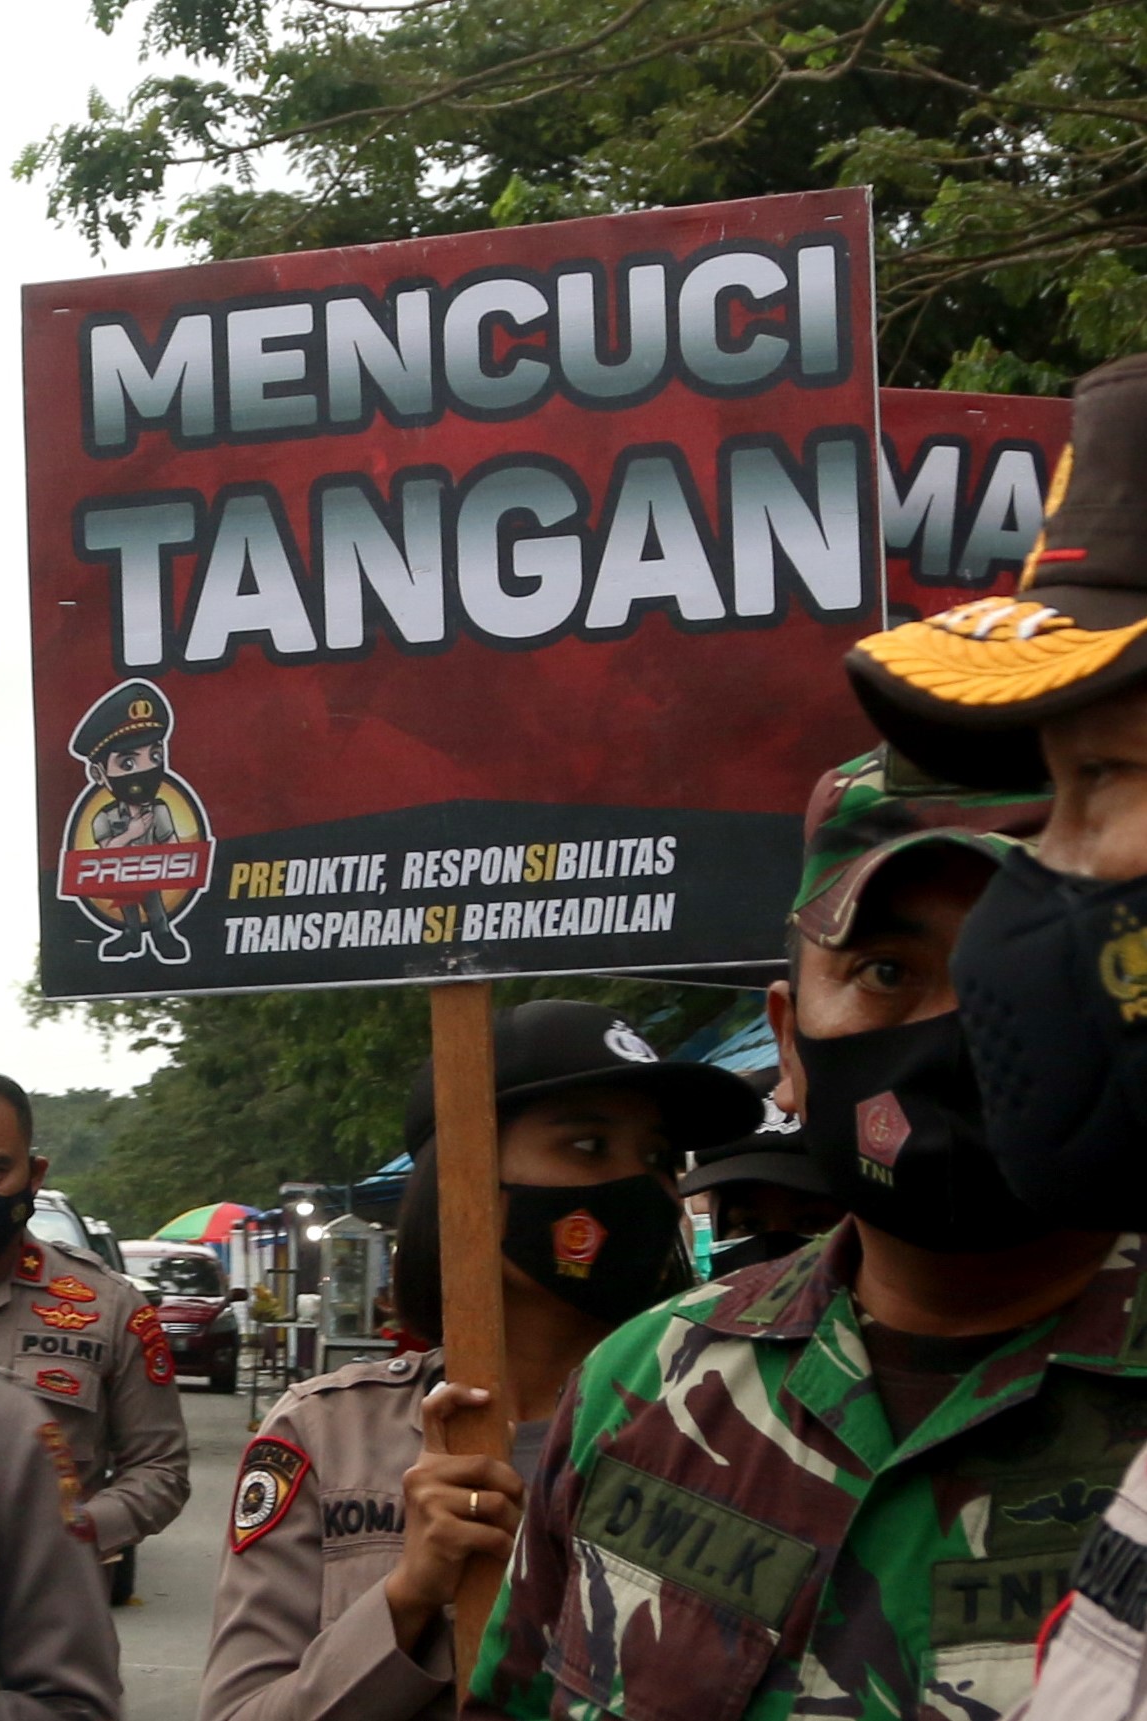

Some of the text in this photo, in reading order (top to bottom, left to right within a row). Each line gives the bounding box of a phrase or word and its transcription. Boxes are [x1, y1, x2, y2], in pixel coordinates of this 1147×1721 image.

[89, 245, 839, 447] MENCUCI
[84, 440, 862, 667] TANGAN
[77, 852, 198, 885] PRESISI
[228, 835, 677, 900] PREDIKTIF, RESPONSIBILITAS
[224, 892, 676, 955] TRANSPARANSI BERKEADILAN
[859, 1156, 894, 1188] TNI
[21, 1333, 102, 1363] POLRI
